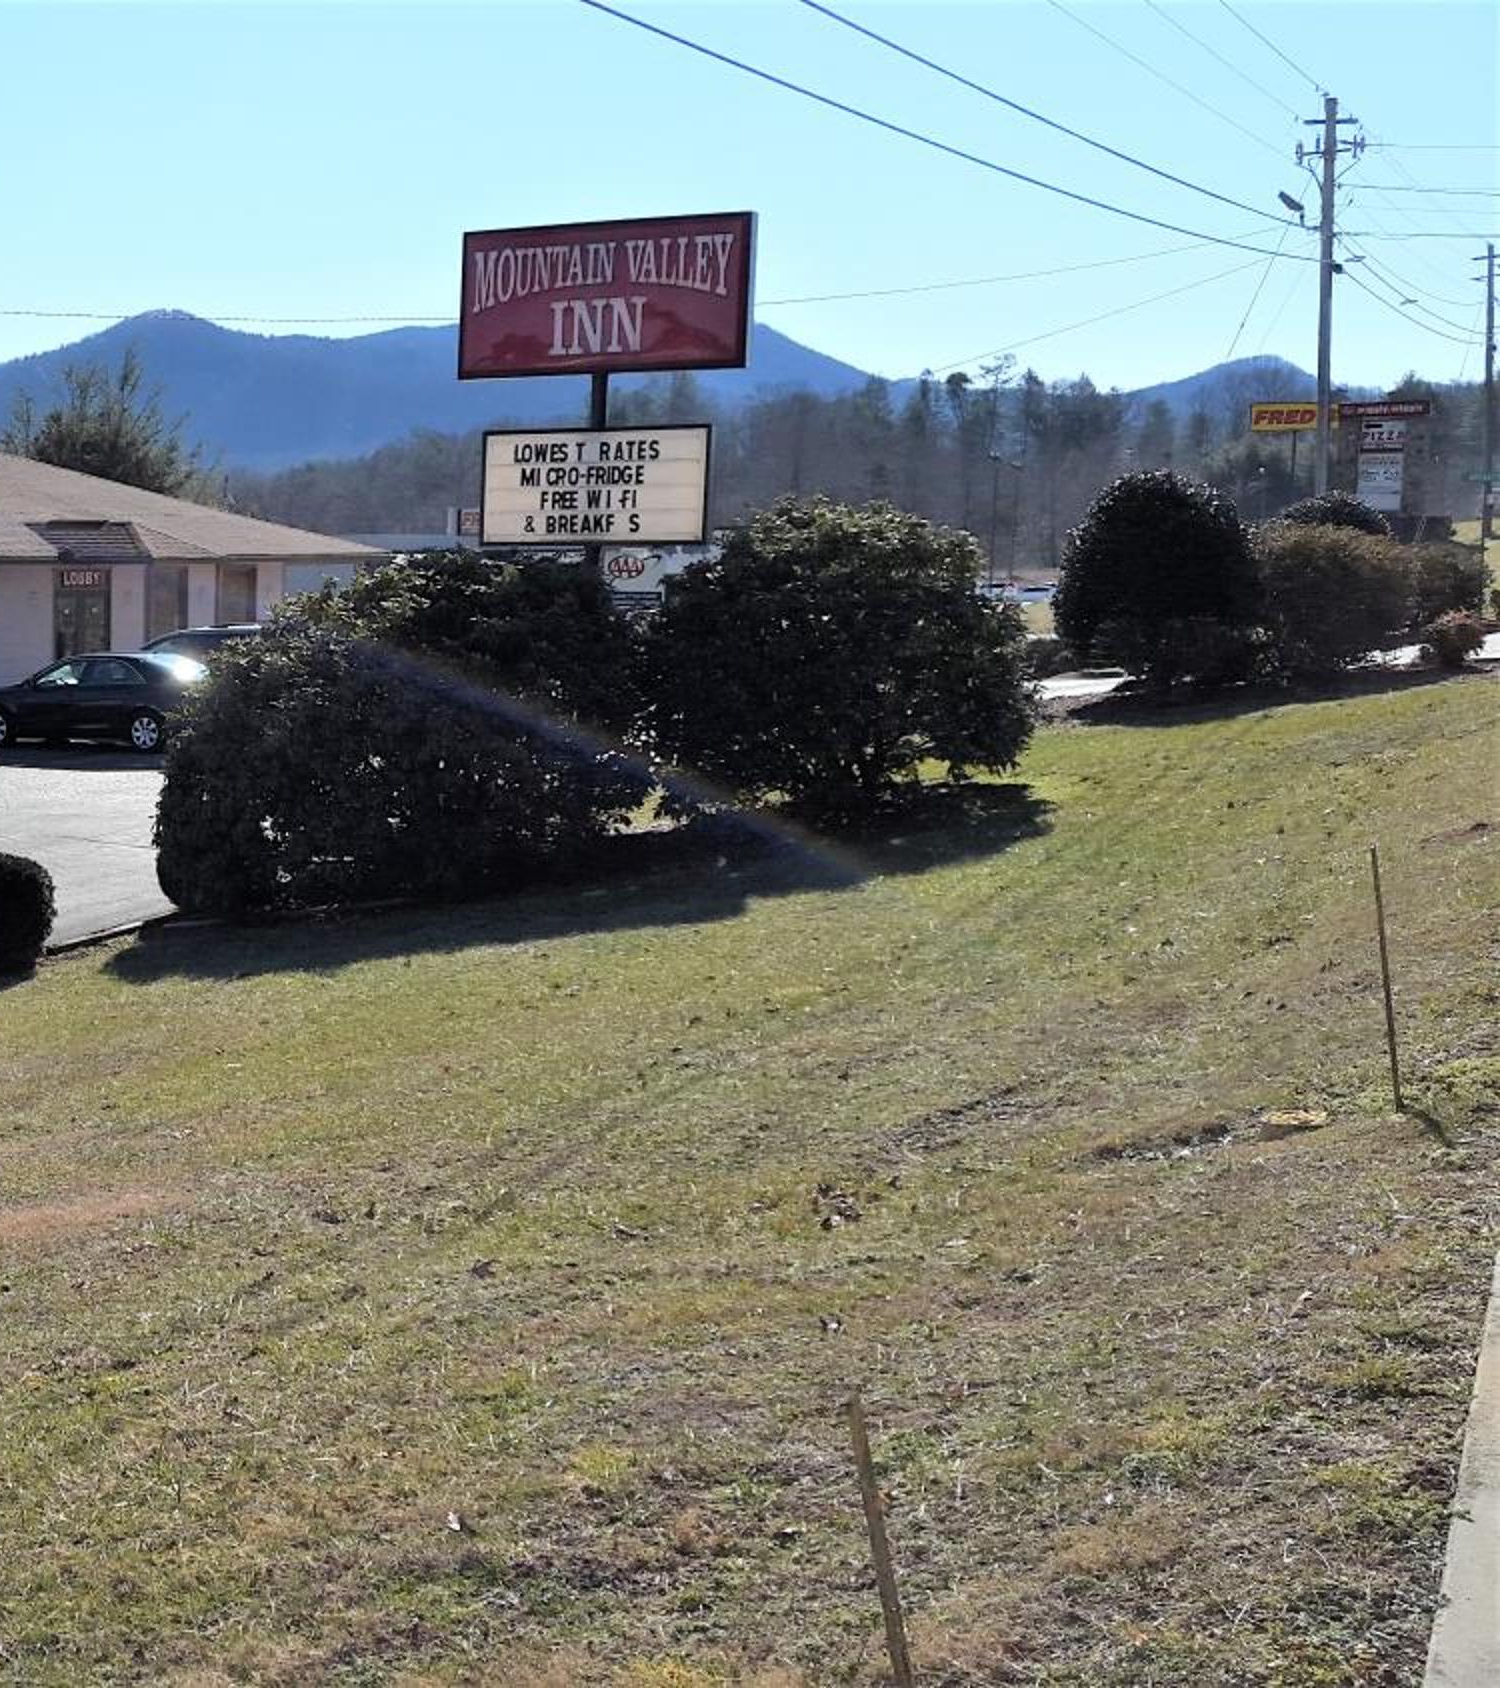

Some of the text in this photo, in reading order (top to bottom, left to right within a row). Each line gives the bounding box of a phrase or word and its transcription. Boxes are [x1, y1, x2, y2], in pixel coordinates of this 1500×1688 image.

[472, 233, 734, 314] MOUNTAIN VALLEY
[548, 296, 648, 356] INN
[1253, 409, 1338, 425] FRED
[599, 440, 660, 461] RATES
[540, 490, 578, 510] FREE
[523, 515, 535, 533] &
[63, 571, 101, 586] LOBBY
